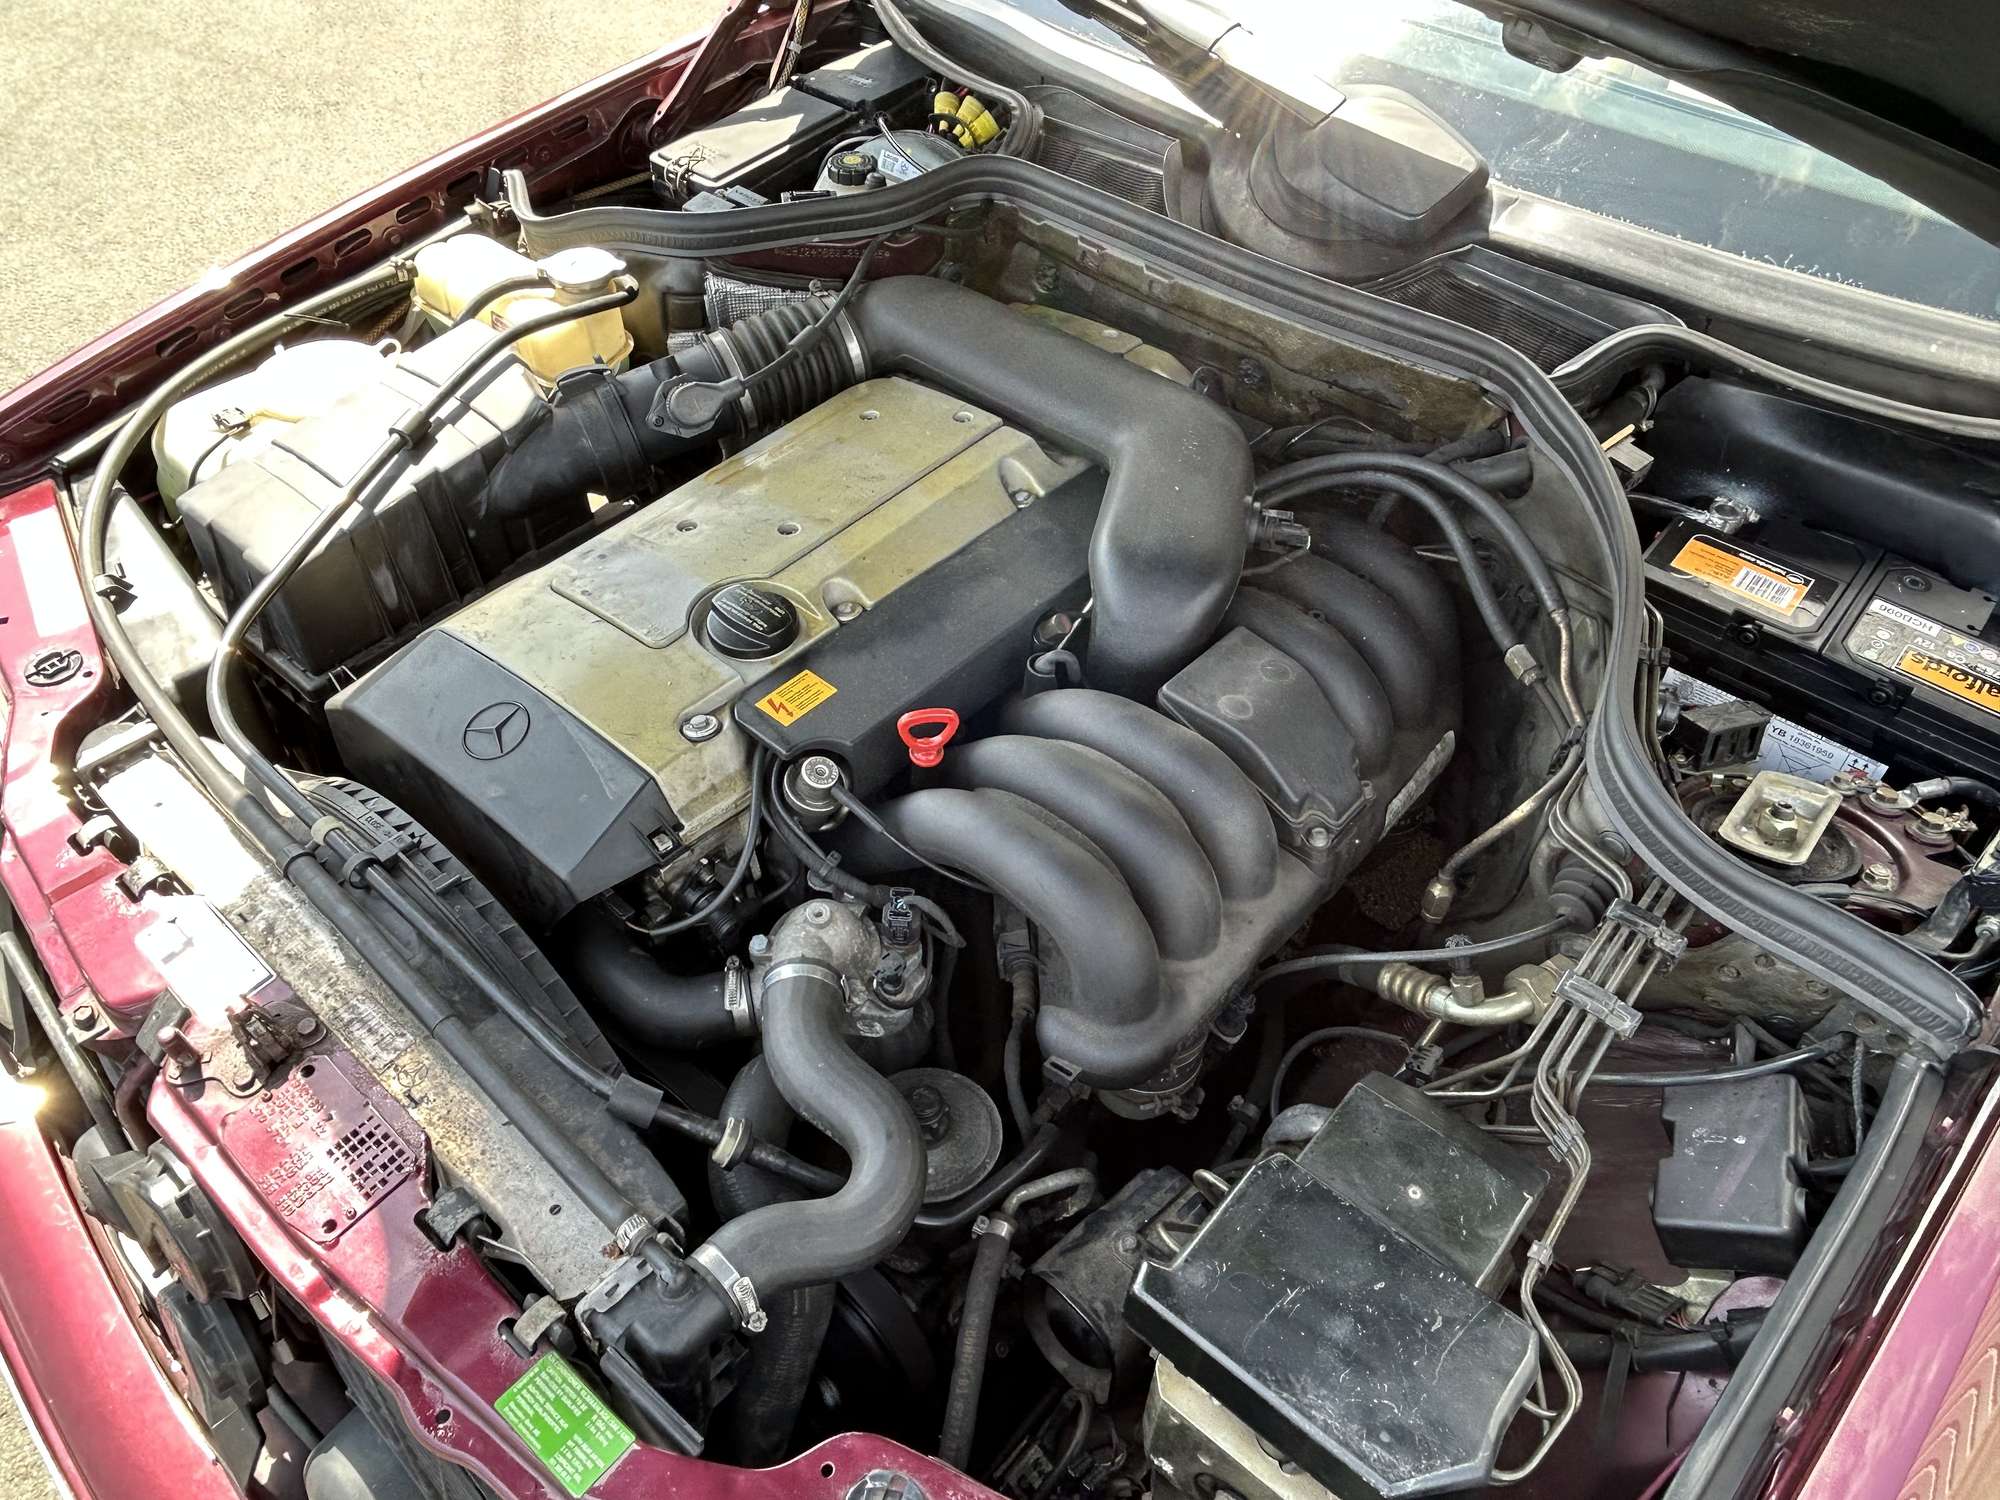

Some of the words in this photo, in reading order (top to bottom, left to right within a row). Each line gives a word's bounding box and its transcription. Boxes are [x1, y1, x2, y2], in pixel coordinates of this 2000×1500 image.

[1913, 636, 1937, 650] 12V
[1910, 651, 2000, 698] alfords
[1772, 725, 1787, 737] YB
